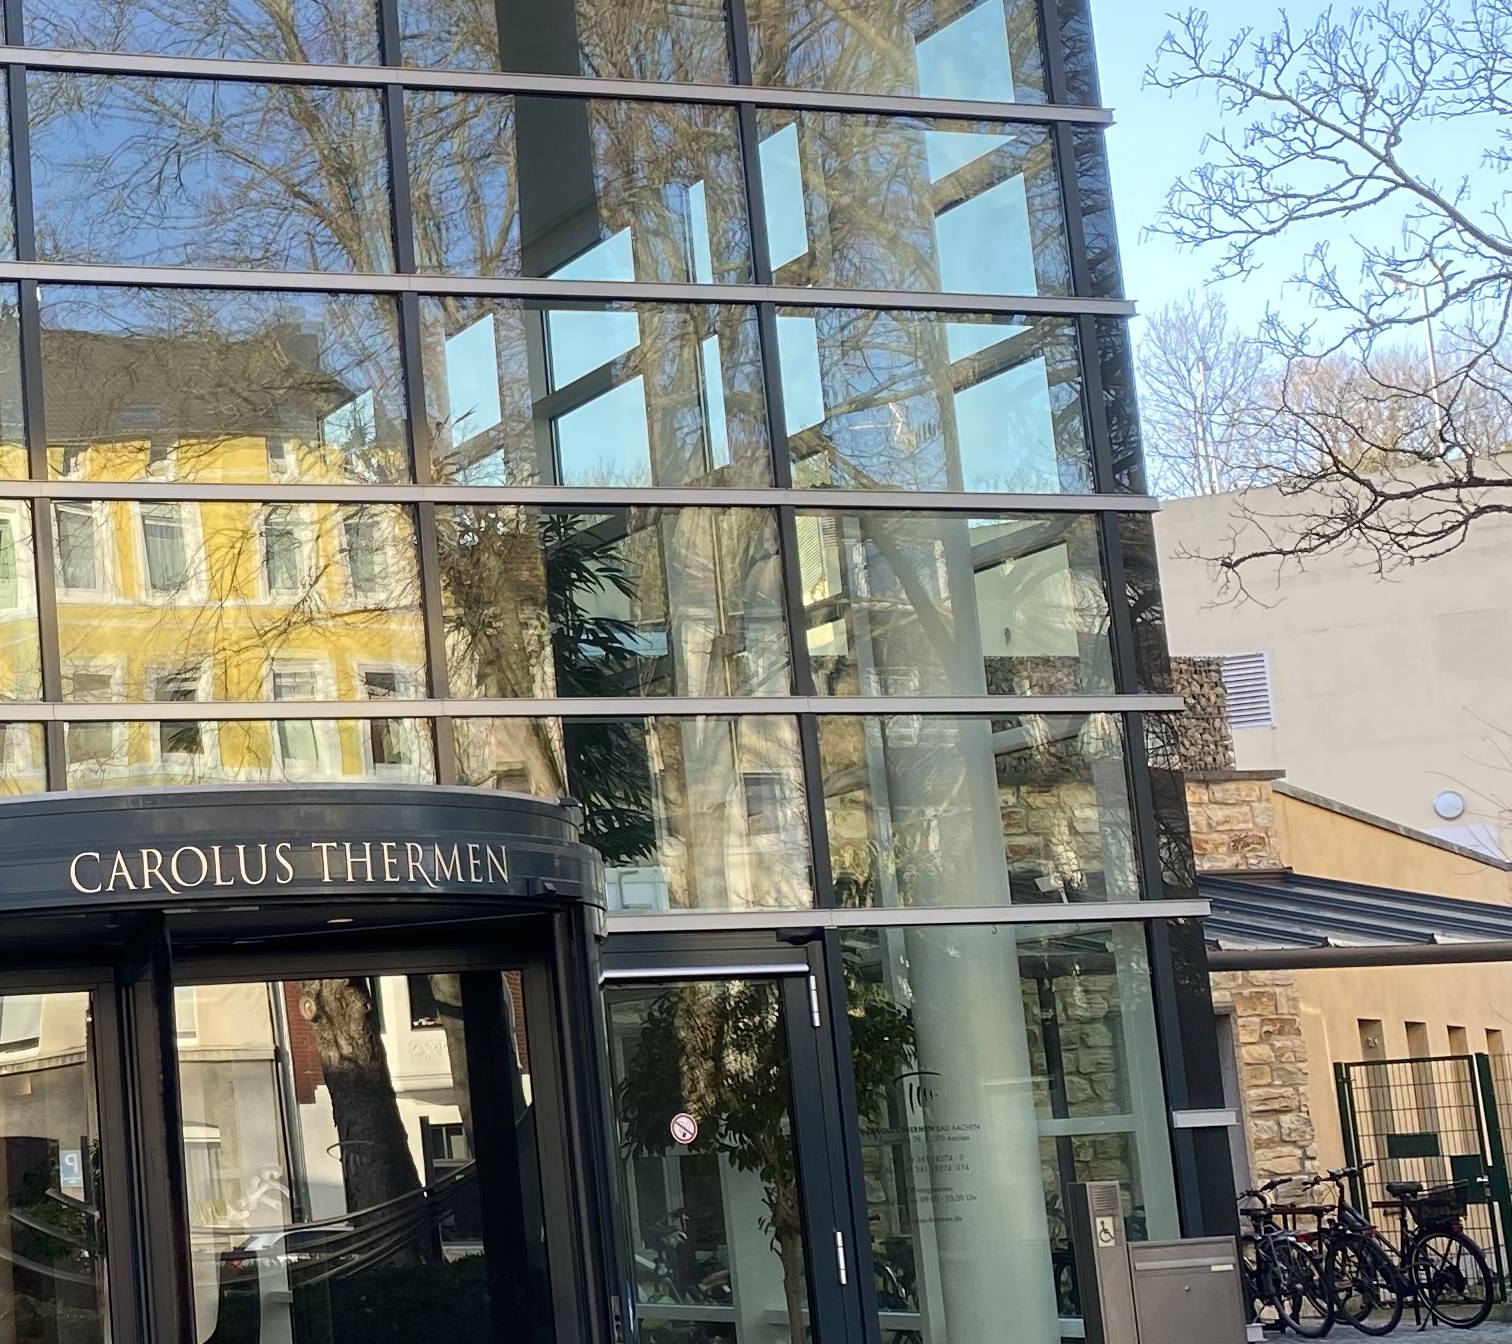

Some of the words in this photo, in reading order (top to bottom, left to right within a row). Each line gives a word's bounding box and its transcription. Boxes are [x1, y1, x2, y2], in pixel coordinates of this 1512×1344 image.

[69, 842, 295, 895] CAROLUS
[311, 841, 511, 889] THERMEN
[951, 1123, 981, 1131] AACHEN
